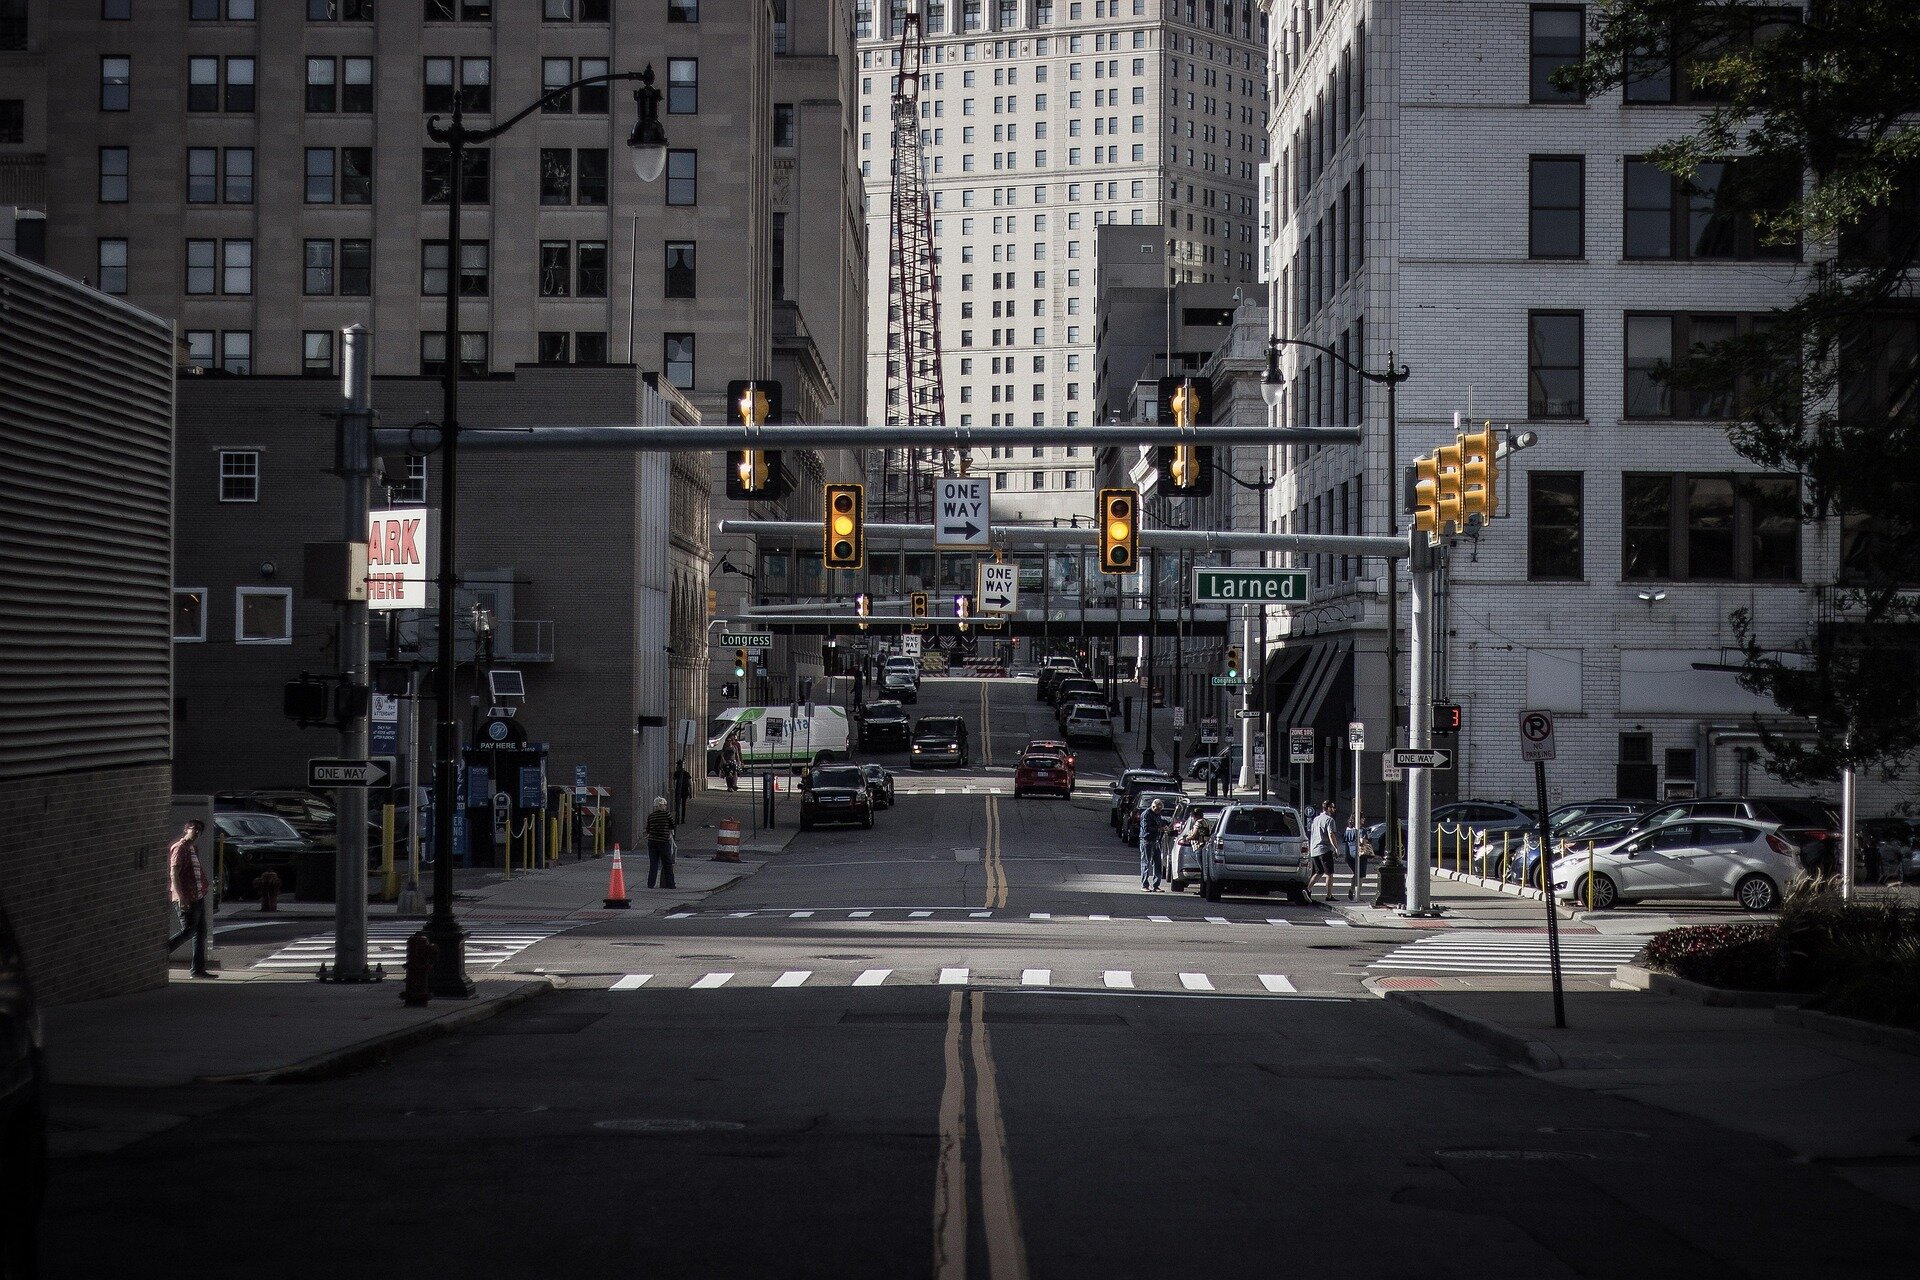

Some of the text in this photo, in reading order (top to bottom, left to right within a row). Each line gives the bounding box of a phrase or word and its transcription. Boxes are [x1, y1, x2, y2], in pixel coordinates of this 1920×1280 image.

[945, 484, 980, 499] ONE
[943, 502, 982, 518] WAY
[367, 519, 421, 566] ARK
[987, 568, 1012, 579] ONE
[367, 573, 405, 600] HERE
[985, 580, 1013, 593] WAY
[1211, 575, 1294, 598] Larned
[721, 634, 771, 647] Congress
[1213, 677, 1237, 685] Congress
[1451, 709, 1459, 727] 3
[1533, 742, 1544, 750] NO
[1399, 755, 1434, 763] ONE WAY
[1526, 750, 1553, 759] PARKING
[317, 768, 367, 779] ONE WAY
